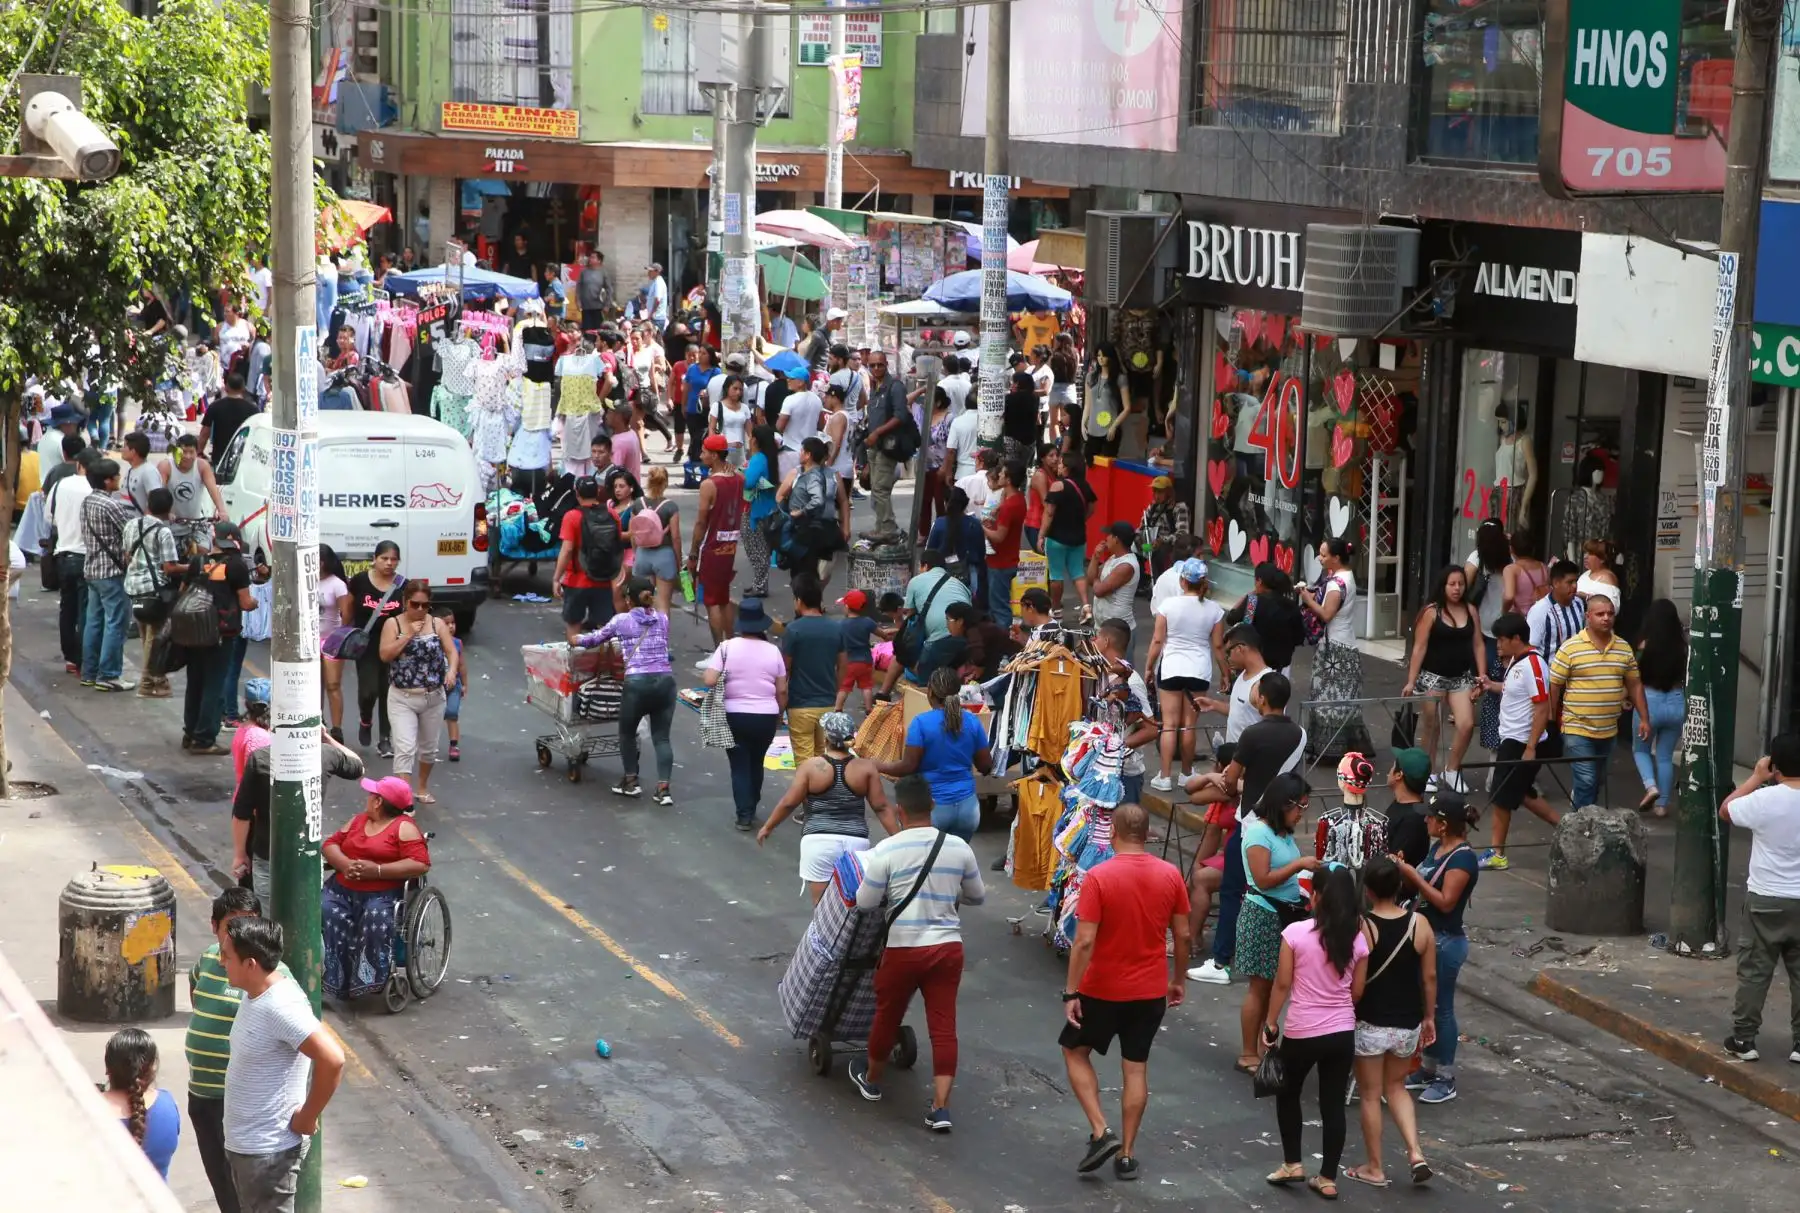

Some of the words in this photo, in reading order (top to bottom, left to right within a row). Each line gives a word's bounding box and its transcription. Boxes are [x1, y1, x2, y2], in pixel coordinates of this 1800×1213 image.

[1573, 28, 1669, 88] HNOS
[444, 103, 576, 119] CORTINAS
[485, 148, 524, 160] PARADA
[1587, 147, 1672, 177] 705
[1474, 262, 1580, 306] ALMEND
[418, 305, 446, 325] POLOS
[1247, 370, 1303, 489] 40
[1709, 423, 1721, 436] DE
[319, 493, 406, 508] HERMES
[1661, 522, 1679, 530] VISA
[1690, 707, 1708, 717] ERO
